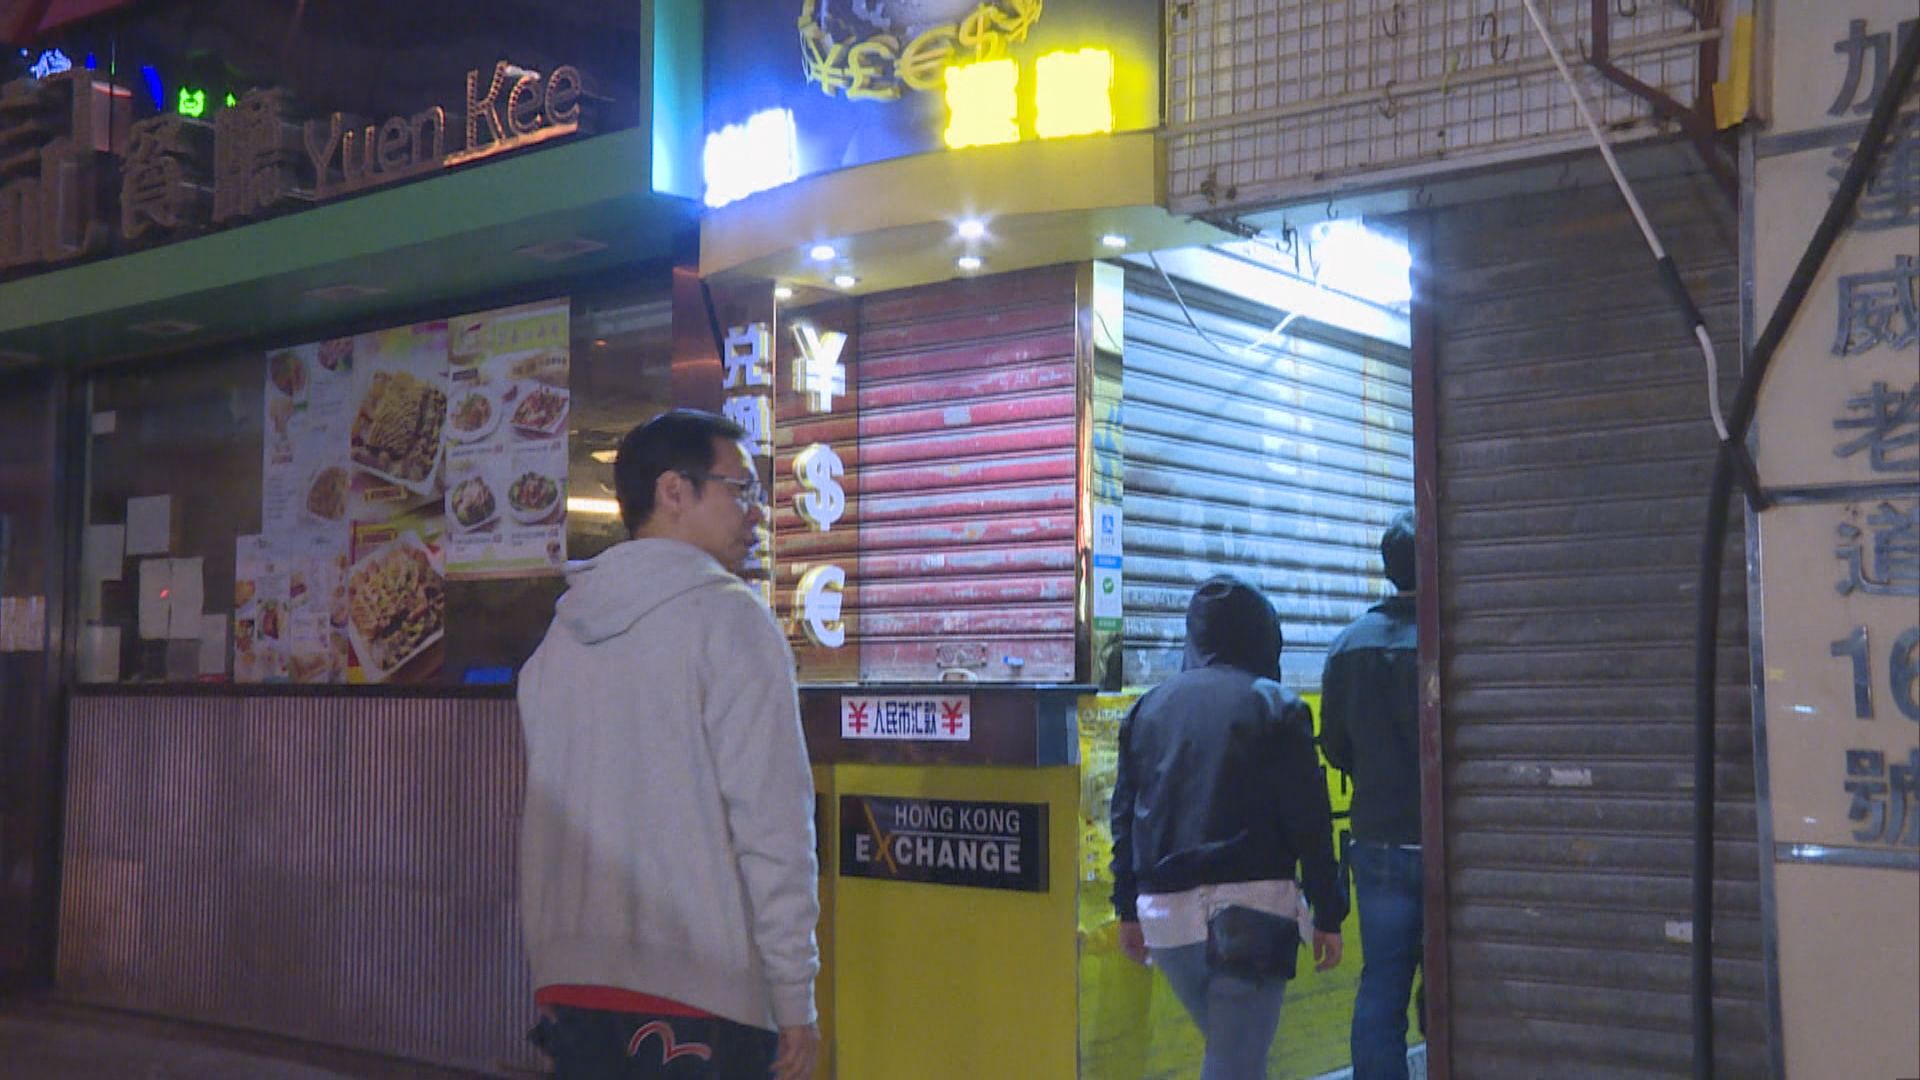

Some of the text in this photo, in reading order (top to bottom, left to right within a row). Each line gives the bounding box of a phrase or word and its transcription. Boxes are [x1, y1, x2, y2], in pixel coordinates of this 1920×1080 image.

[304, 60, 582, 194] Yuen Kee
[874, 702, 937, 735] 人民币汇款
[895, 804, 1021, 834] HONG KONG
[855, 812, 1022, 874] EXCHANGE
